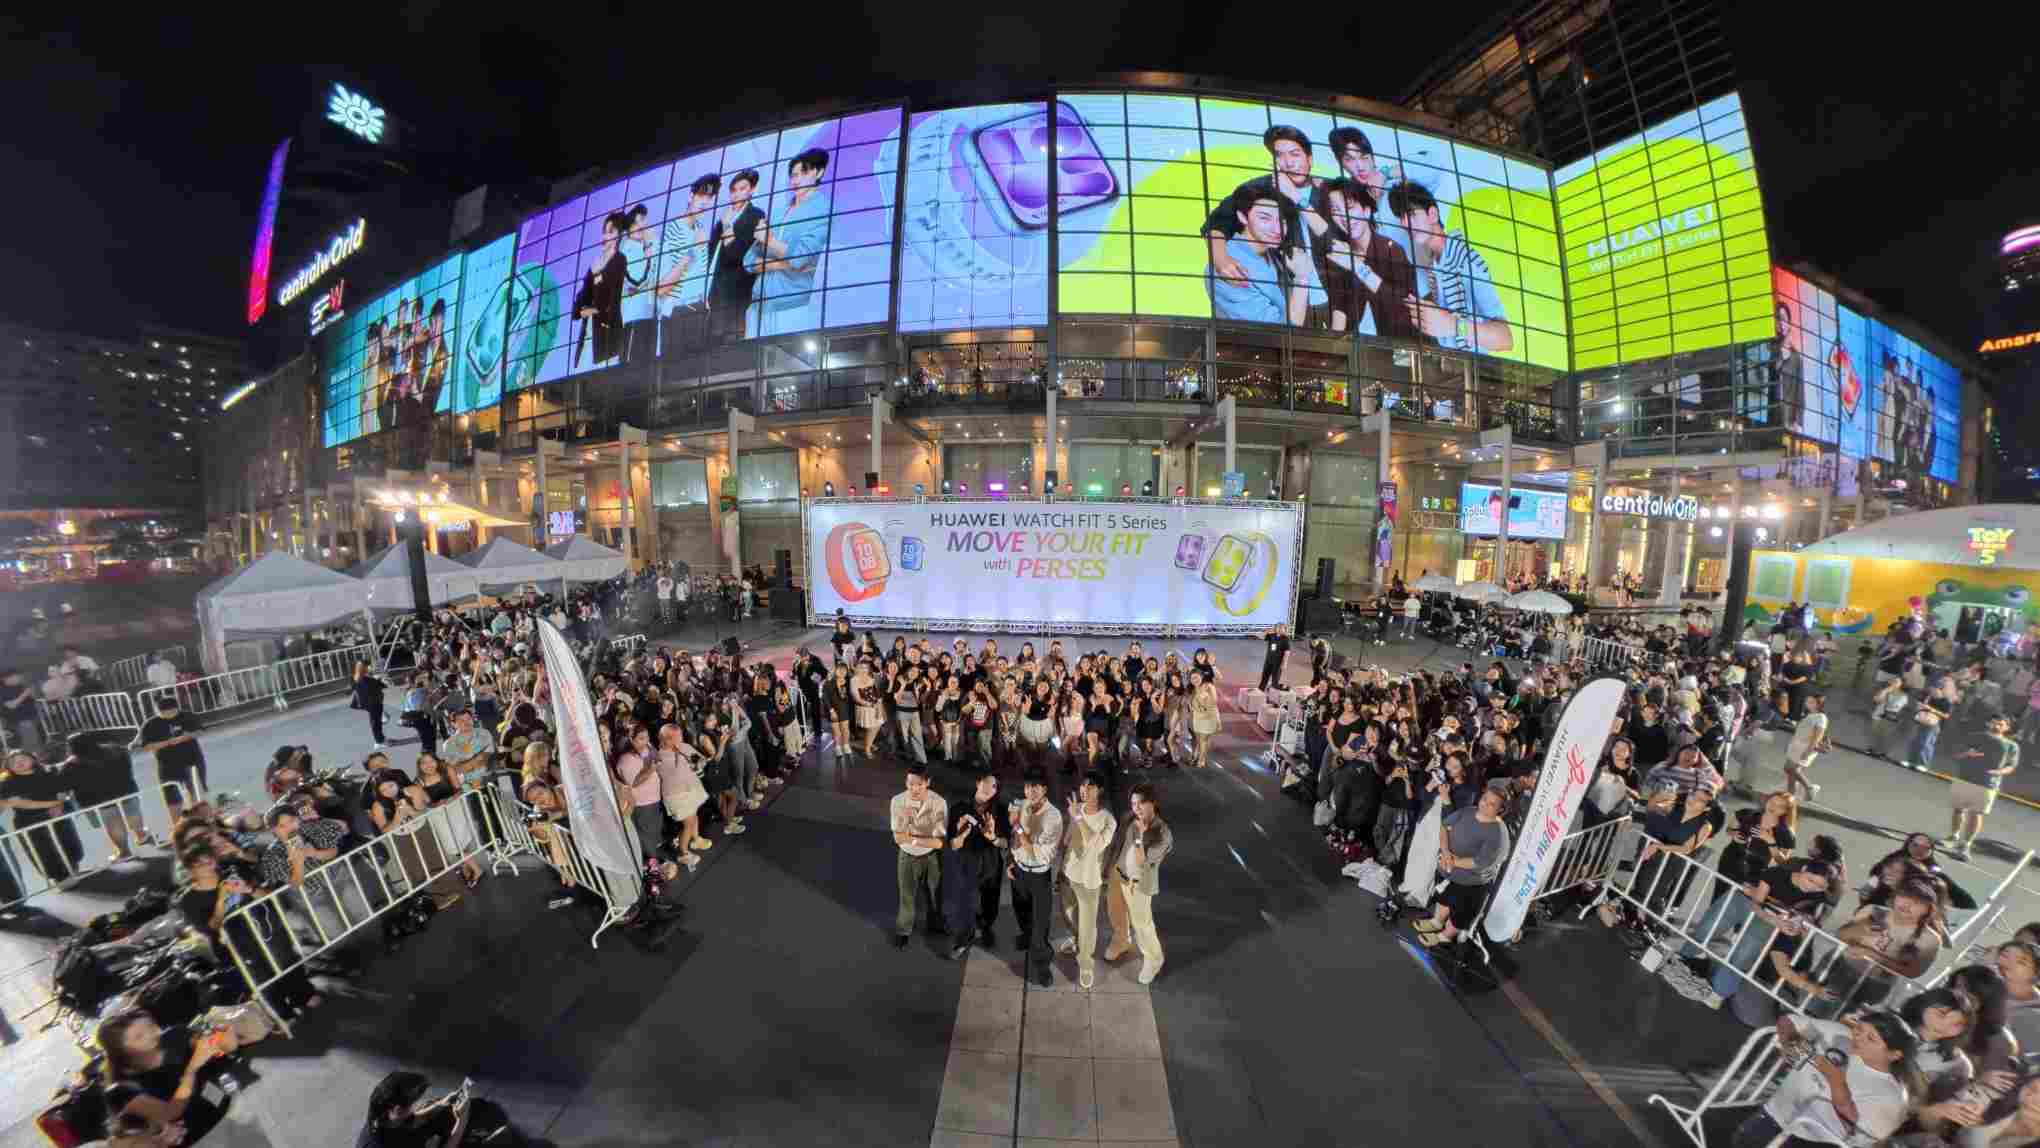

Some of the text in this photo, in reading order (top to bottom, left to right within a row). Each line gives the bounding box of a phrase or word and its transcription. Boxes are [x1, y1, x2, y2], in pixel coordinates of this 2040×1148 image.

[1586, 203, 1713, 257] HUAWEI
[930, 512, 1168, 530] HUAWEI WATCH FIT 5 Series
[946, 530, 1152, 556] MOVE YOUR FIT
[983, 558, 1107, 580] with PERSES
